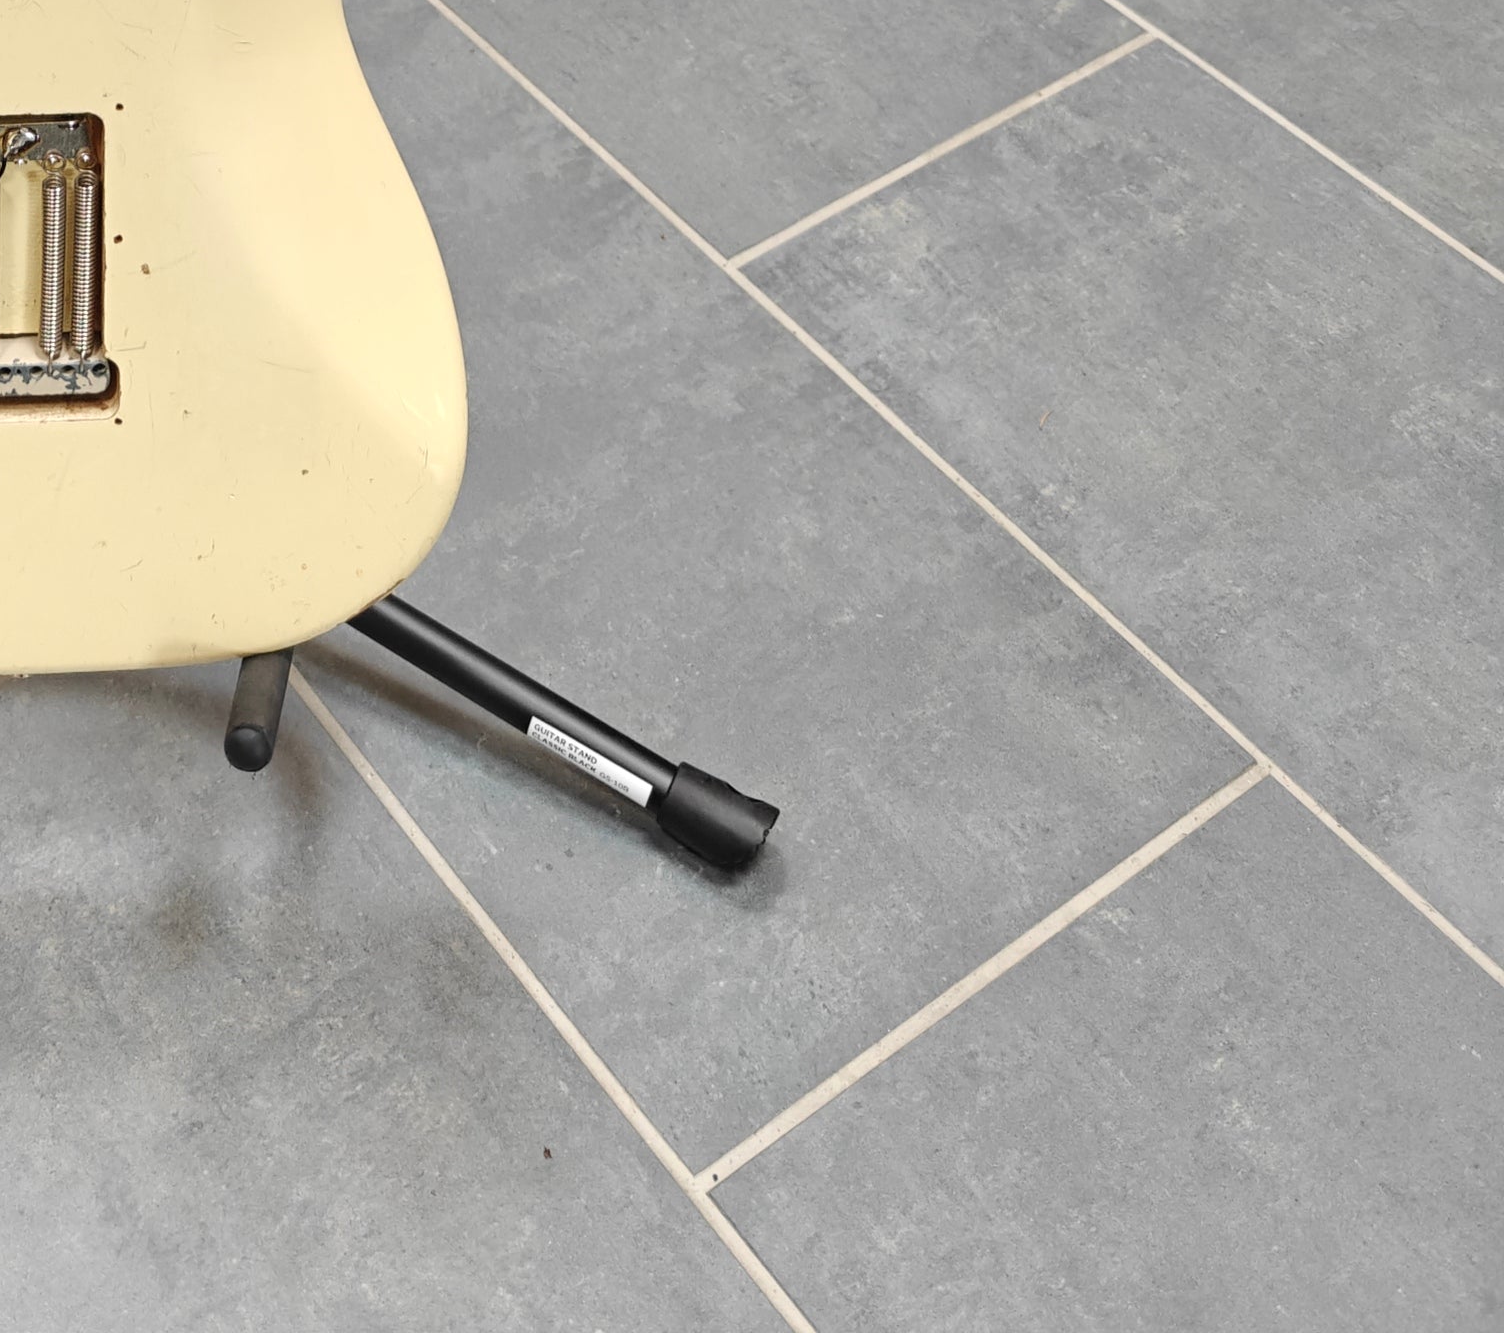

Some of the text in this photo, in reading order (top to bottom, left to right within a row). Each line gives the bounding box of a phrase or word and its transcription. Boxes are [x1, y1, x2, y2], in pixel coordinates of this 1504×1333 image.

[534, 723, 598, 765] GUITAR STAND
[568, 753, 597, 773] BLACK
